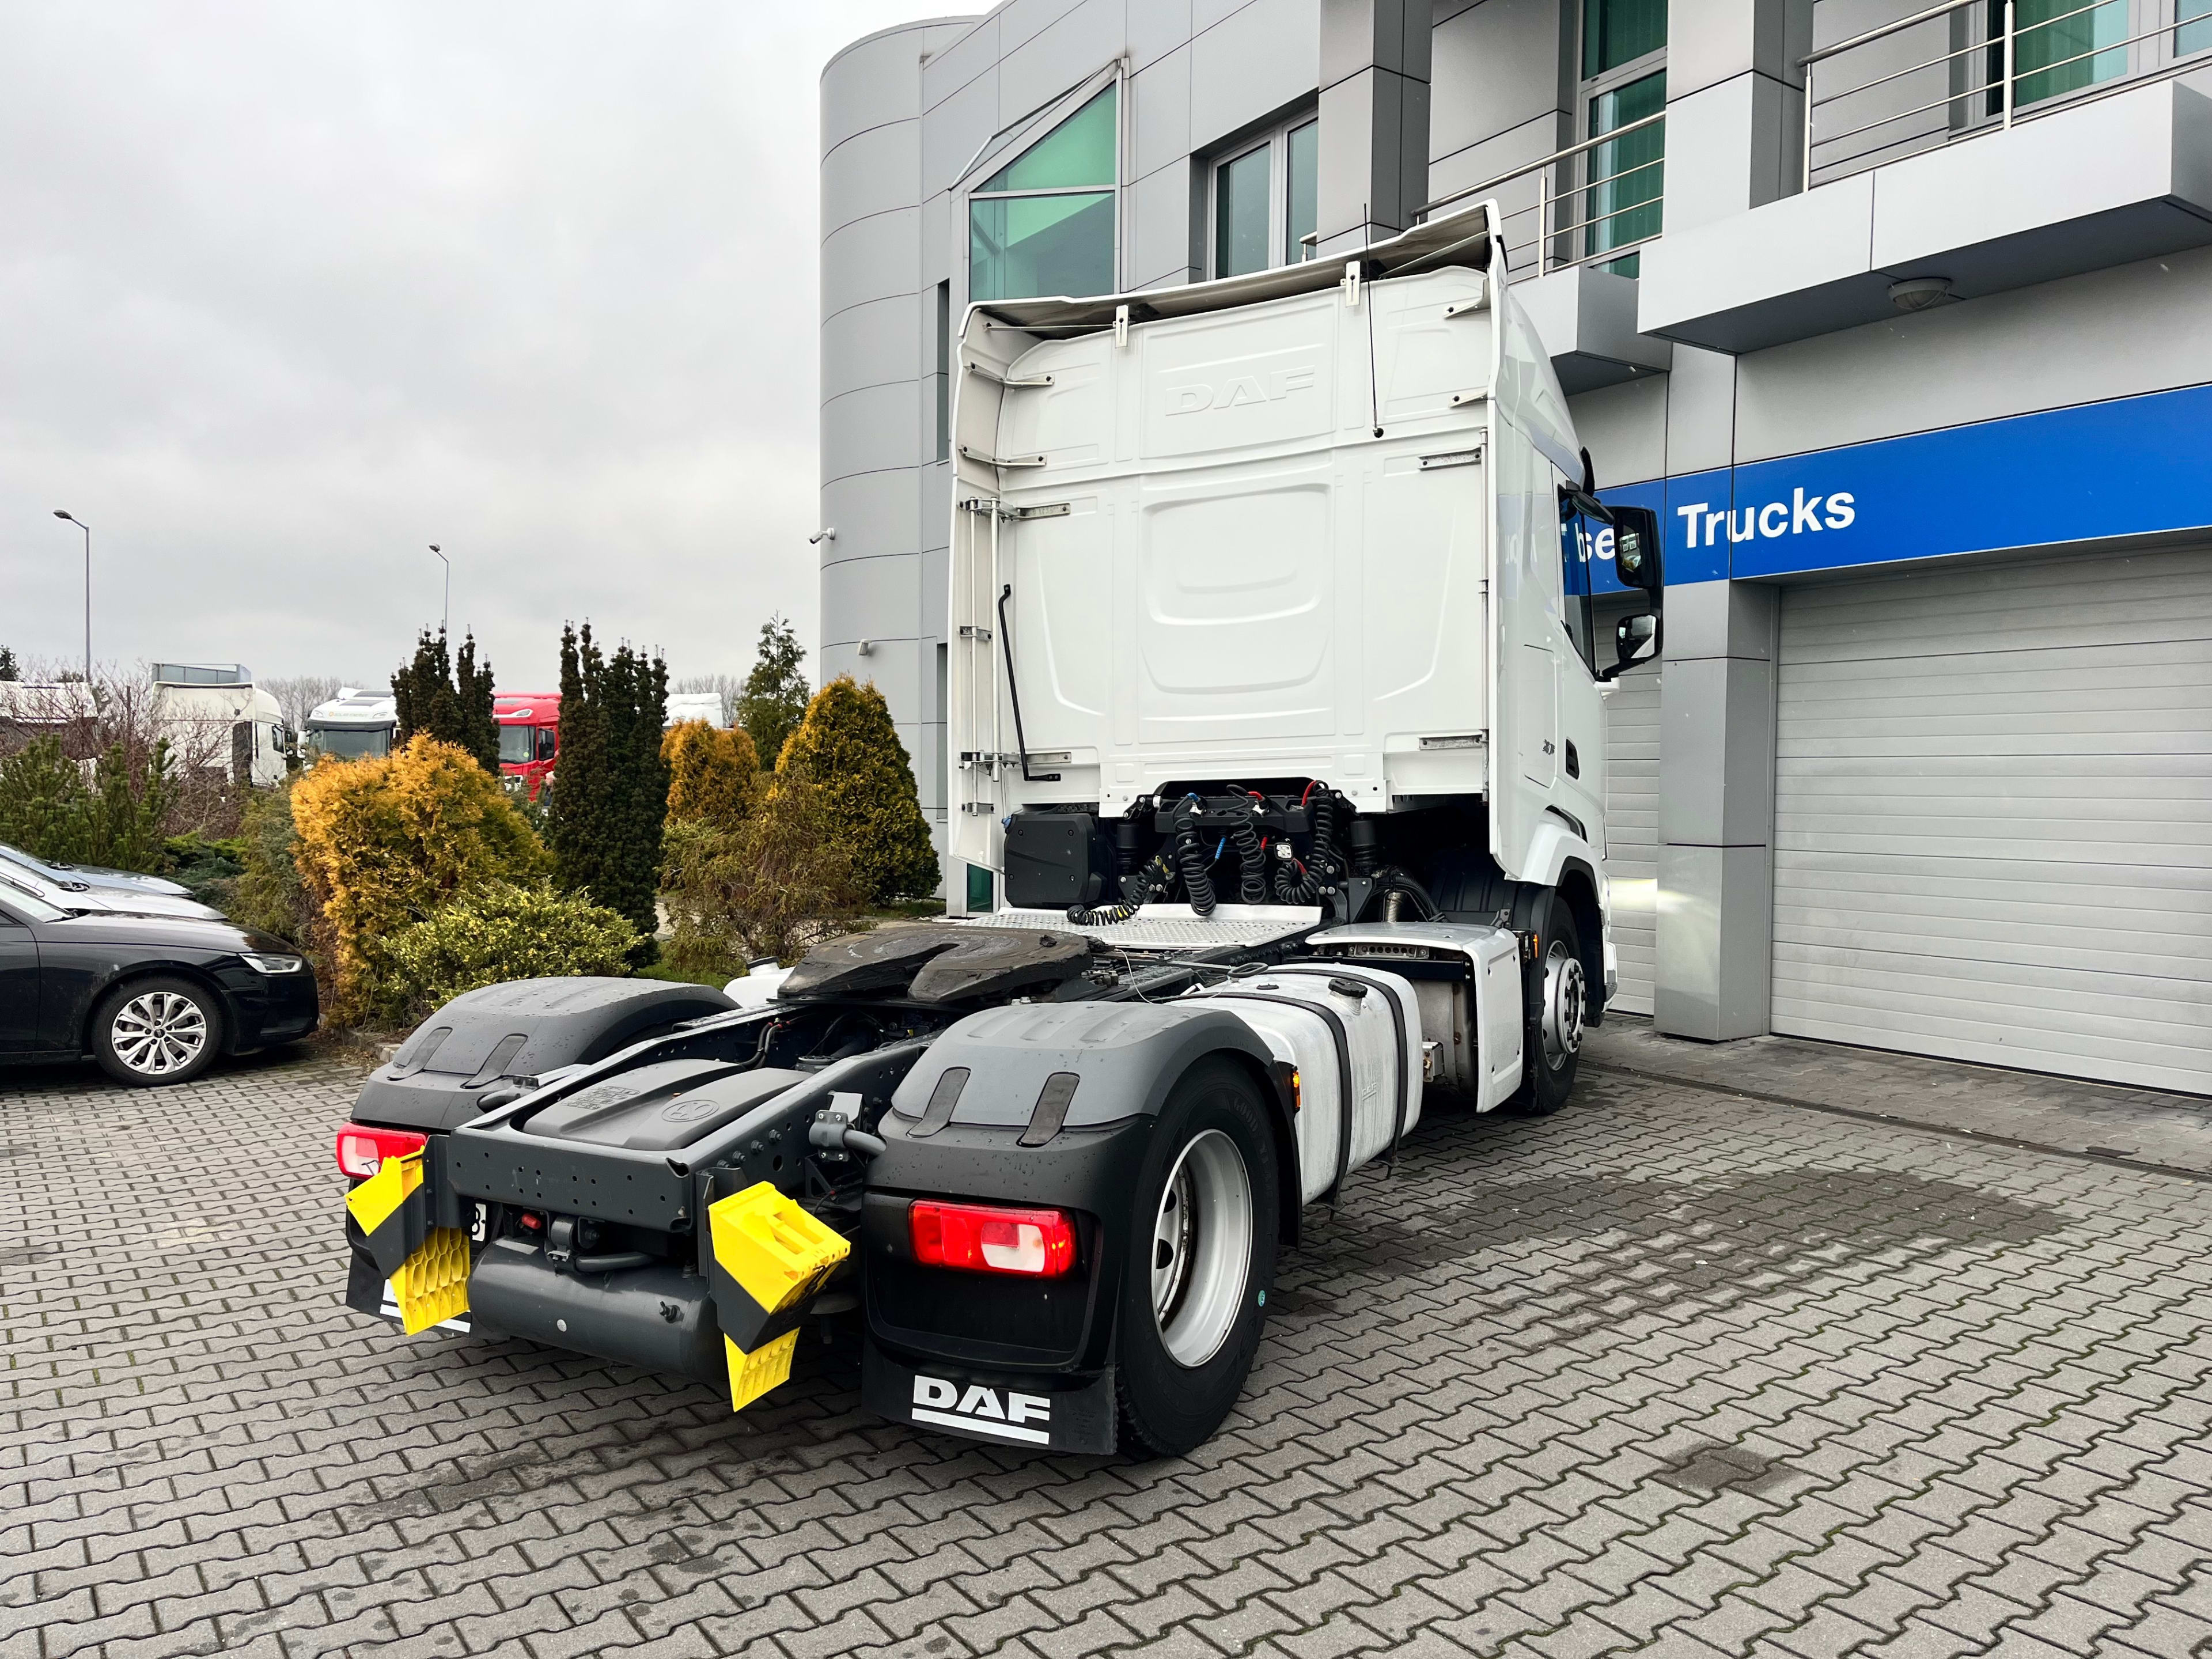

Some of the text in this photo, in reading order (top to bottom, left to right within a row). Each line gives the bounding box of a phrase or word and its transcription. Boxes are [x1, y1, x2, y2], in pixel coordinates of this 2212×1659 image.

[1165, 365, 1315, 416] DAF
[1677, 487, 1855, 548] Trucks
[913, 1374, 1051, 1423] DAF
